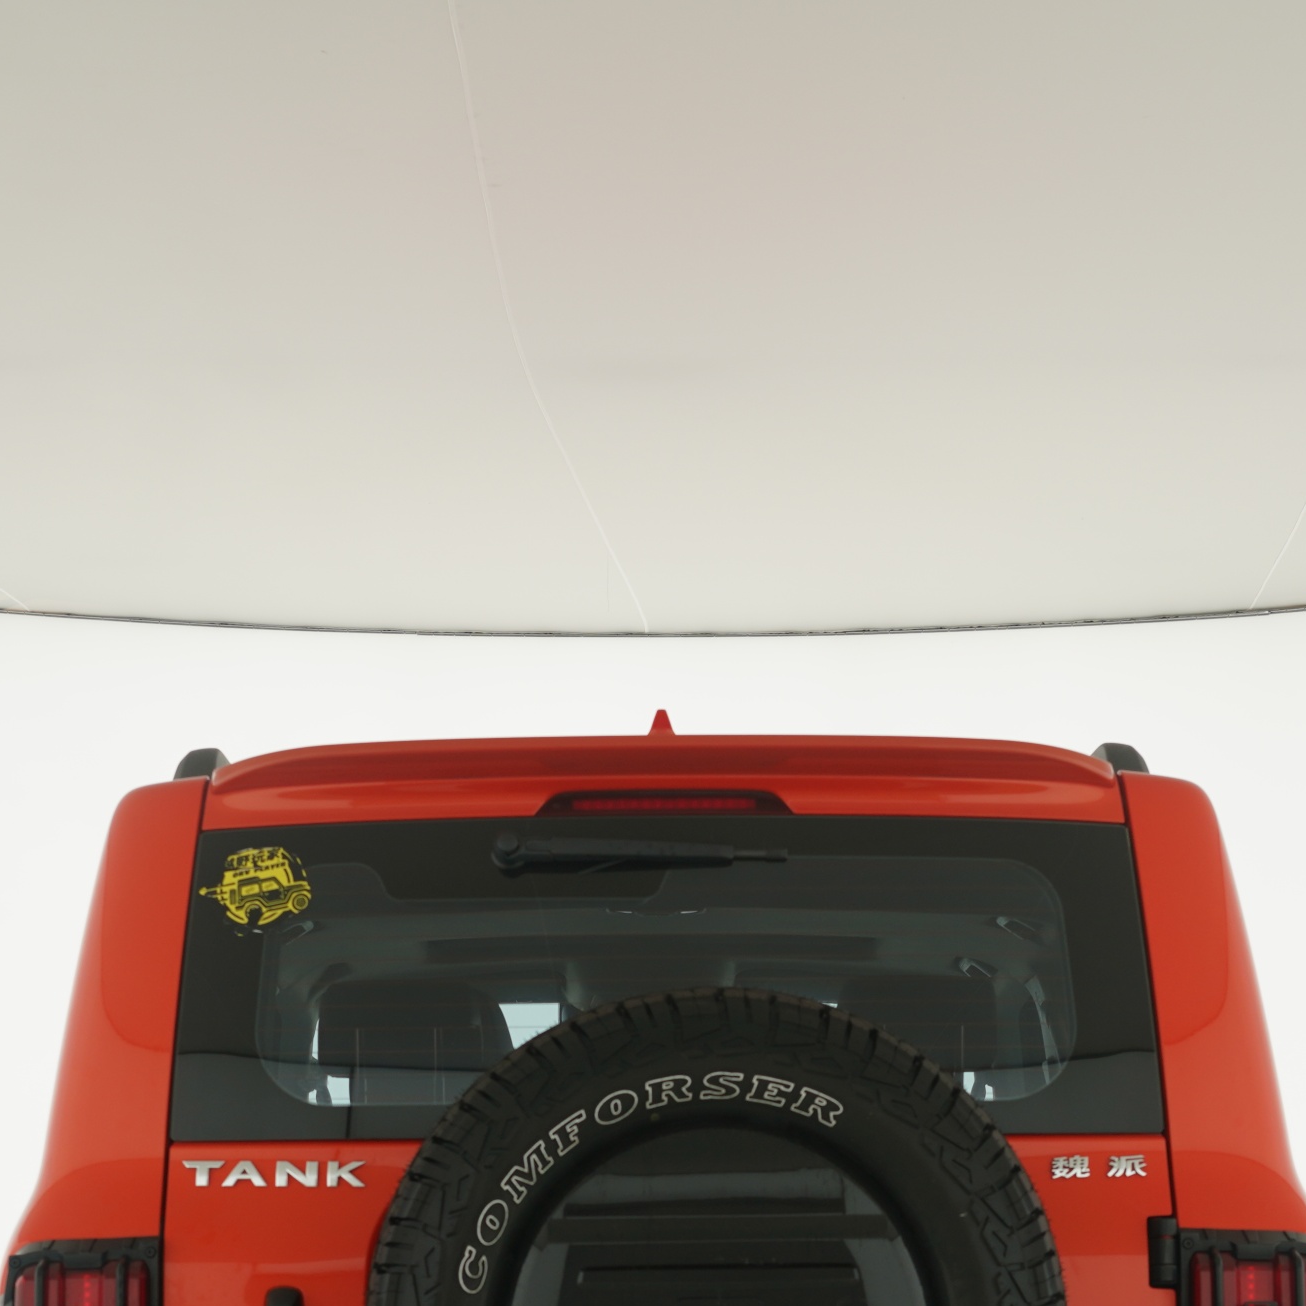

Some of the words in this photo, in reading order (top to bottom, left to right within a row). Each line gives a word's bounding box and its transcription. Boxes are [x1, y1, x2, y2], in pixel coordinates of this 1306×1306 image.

[181, 1159, 367, 1188] TANK
[1051, 1154, 1147, 1179] 魏派
[458, 1071, 844, 1294] COMFORSER
